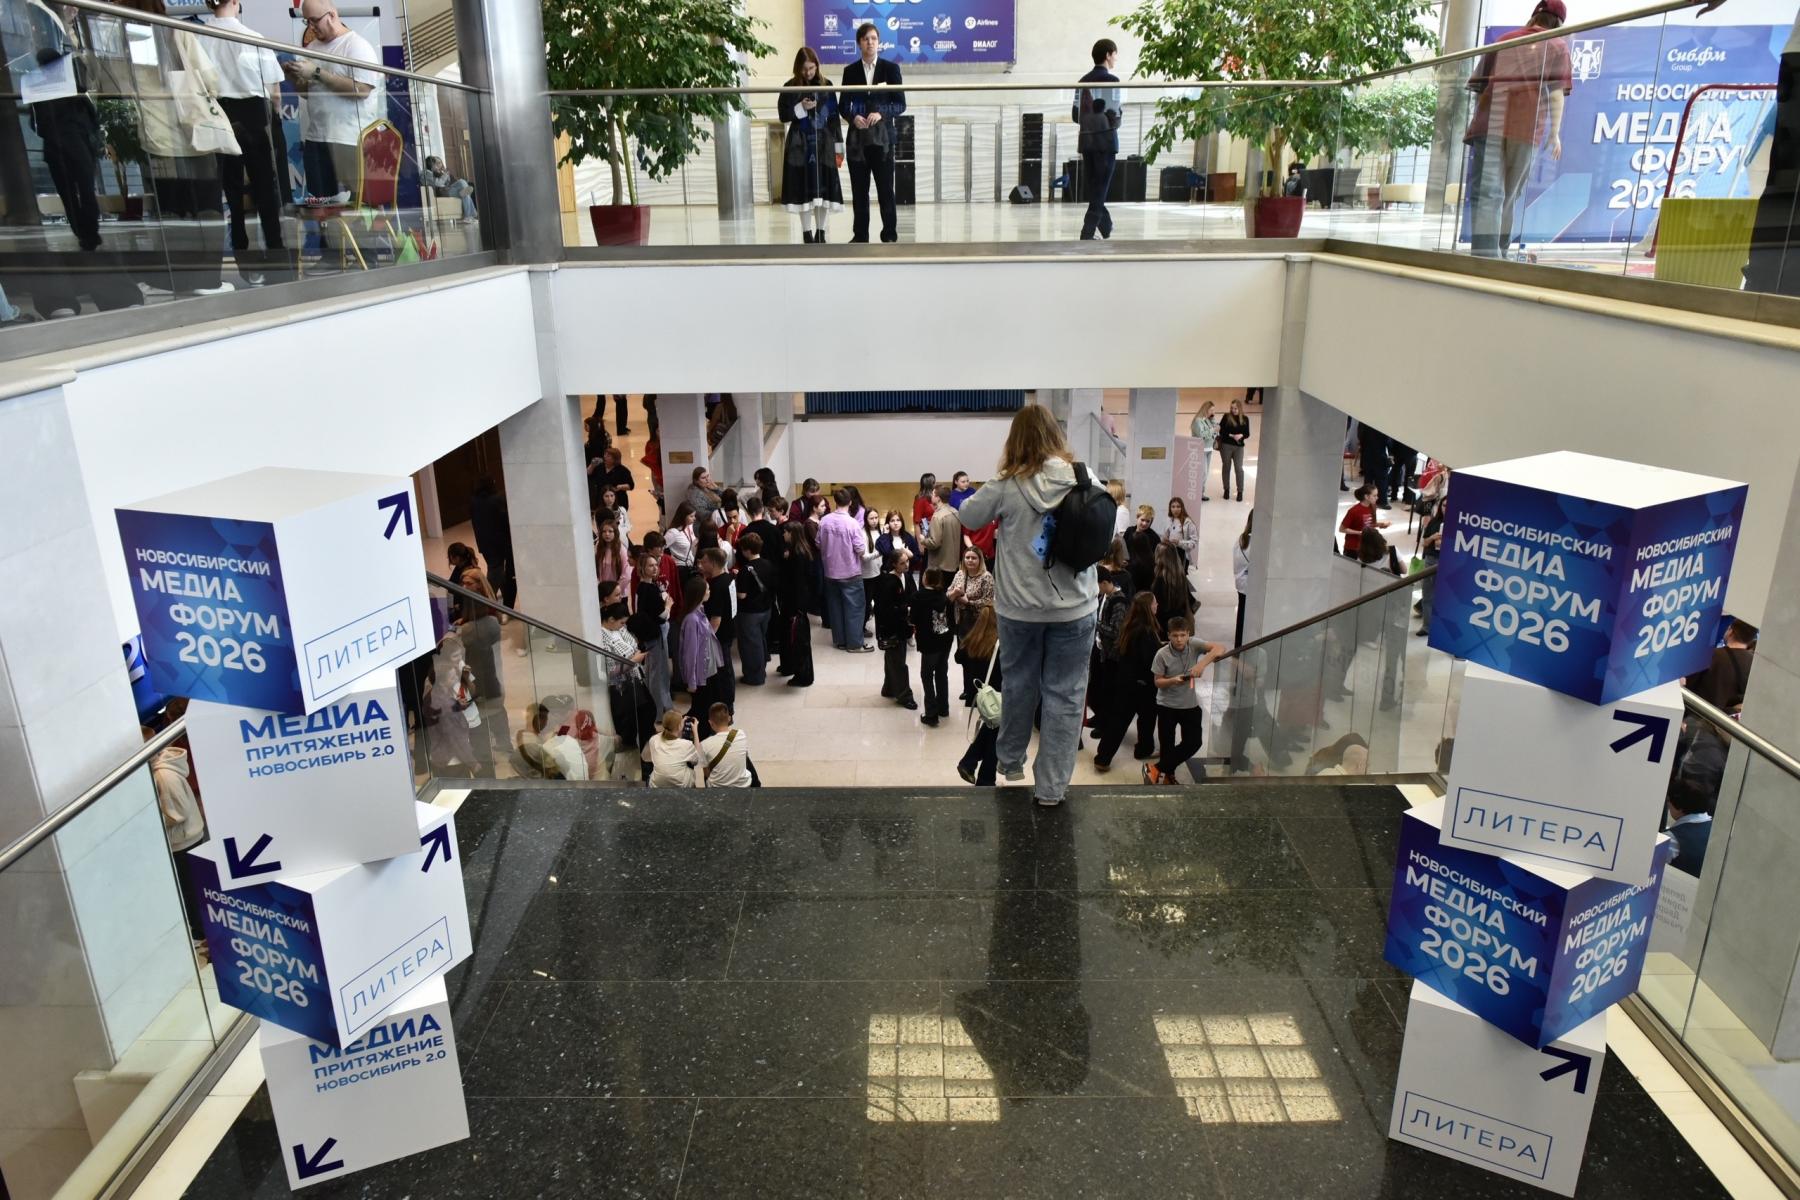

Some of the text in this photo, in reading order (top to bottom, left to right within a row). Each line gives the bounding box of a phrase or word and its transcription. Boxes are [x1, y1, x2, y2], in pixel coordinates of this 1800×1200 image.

[1666, 46, 1727, 66] Сиб.фм
[1671, 63, 1693, 72] Group
[1616, 83, 1777, 101] НОВОСИБИРСКИ
[1593, 111, 1732, 144] МЕДИА
[1630, 144, 1748, 175] ФОРУ
[1454, 530, 1566, 581] МЕДИА
[1458, 511, 1612, 560] НОВОСИБИРСКИЙ
[1636, 525, 1733, 562] НОВОСИБИРСКИЙ
[136, 548, 270, 576] НОВОСИБИРСКИЙ
[139, 568, 243, 602] МЕДИА
[1630, 552, 1704, 593] МЕДИА
[1474, 569, 1601, 624] ФОРУМ
[1642, 576, 1722, 618] ФОРУМ
[169, 603, 280, 638] ФОРУМ
[1469, 596, 1570, 653] 2026
[1633, 610, 1701, 659] 2026
[175, 632, 266, 673] 2026
[316, 619, 409, 680] ЛИТЕРА
[239, 699, 390, 743] МЕДИА
[246, 727, 392, 762] ПРИТЯЖЕНИЕ
[249, 744, 395, 778] НОВОСИБИРЬ 2.0
[1463, 806, 1606, 852] ЛИТЕРА
[203, 887, 310, 934] НОВОСИБИРСКИЙ
[1406, 865, 1506, 934] МЕДИА
[1409, 850, 1547, 927] НОВОСИБИРСКИЙ
[206, 903, 288, 949] МЕДИА
[1424, 905, 1537, 978] ФОРУМ
[1564, 904, 1631, 955] МЕДИА
[1575, 916, 1648, 970] ФОРУМ
[230, 937, 319, 984] ФОРУМ
[352, 938, 445, 1016] ЛИТЕРА
[1420, 927, 1510, 995] 2026
[1568, 949, 1629, 1004] 2026
[236, 960, 309, 1008] 2026
[314, 1035, 444, 1080] ПРИТЯЖЕНИЕ
[316, 1049, 447, 1093] НОВОСИБИРЬ 2.0
[1410, 1108, 1537, 1163] ЛИТЕРА
